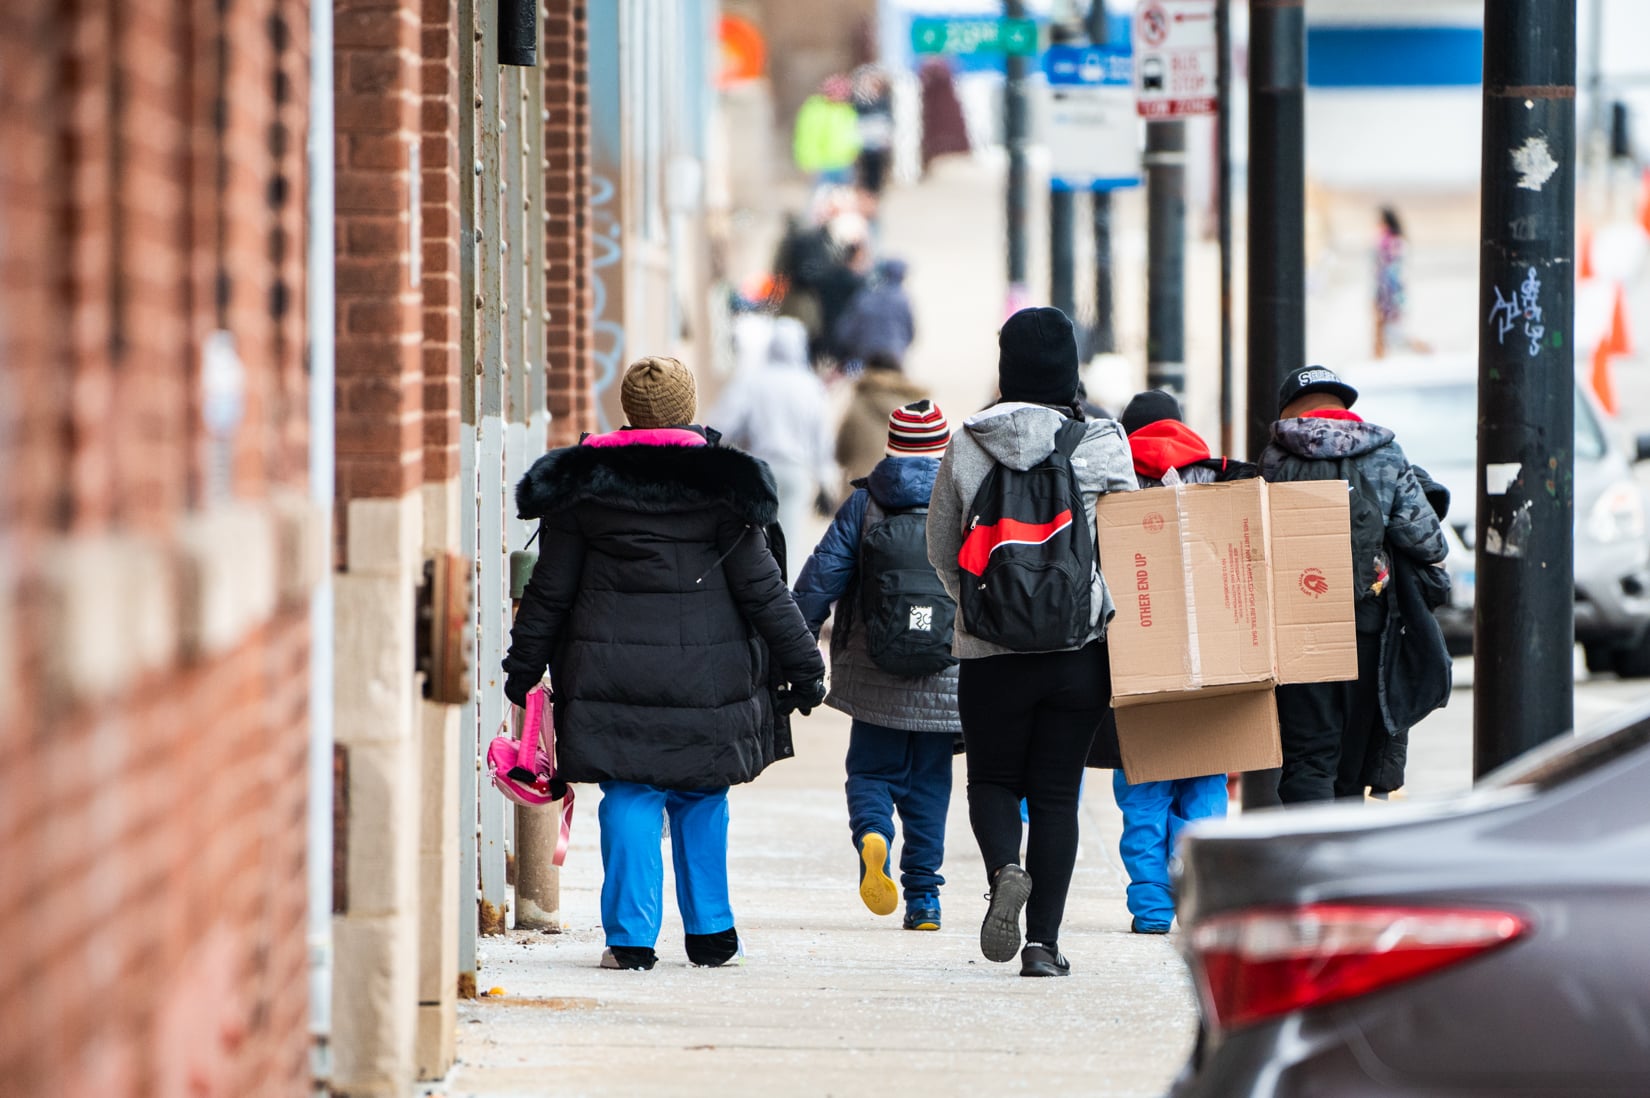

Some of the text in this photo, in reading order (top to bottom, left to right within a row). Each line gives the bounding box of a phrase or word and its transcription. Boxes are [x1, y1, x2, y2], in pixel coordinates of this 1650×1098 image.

[1171, 54, 1198, 71] BUS
[1134, 553, 1152, 627] OTHER END UP
